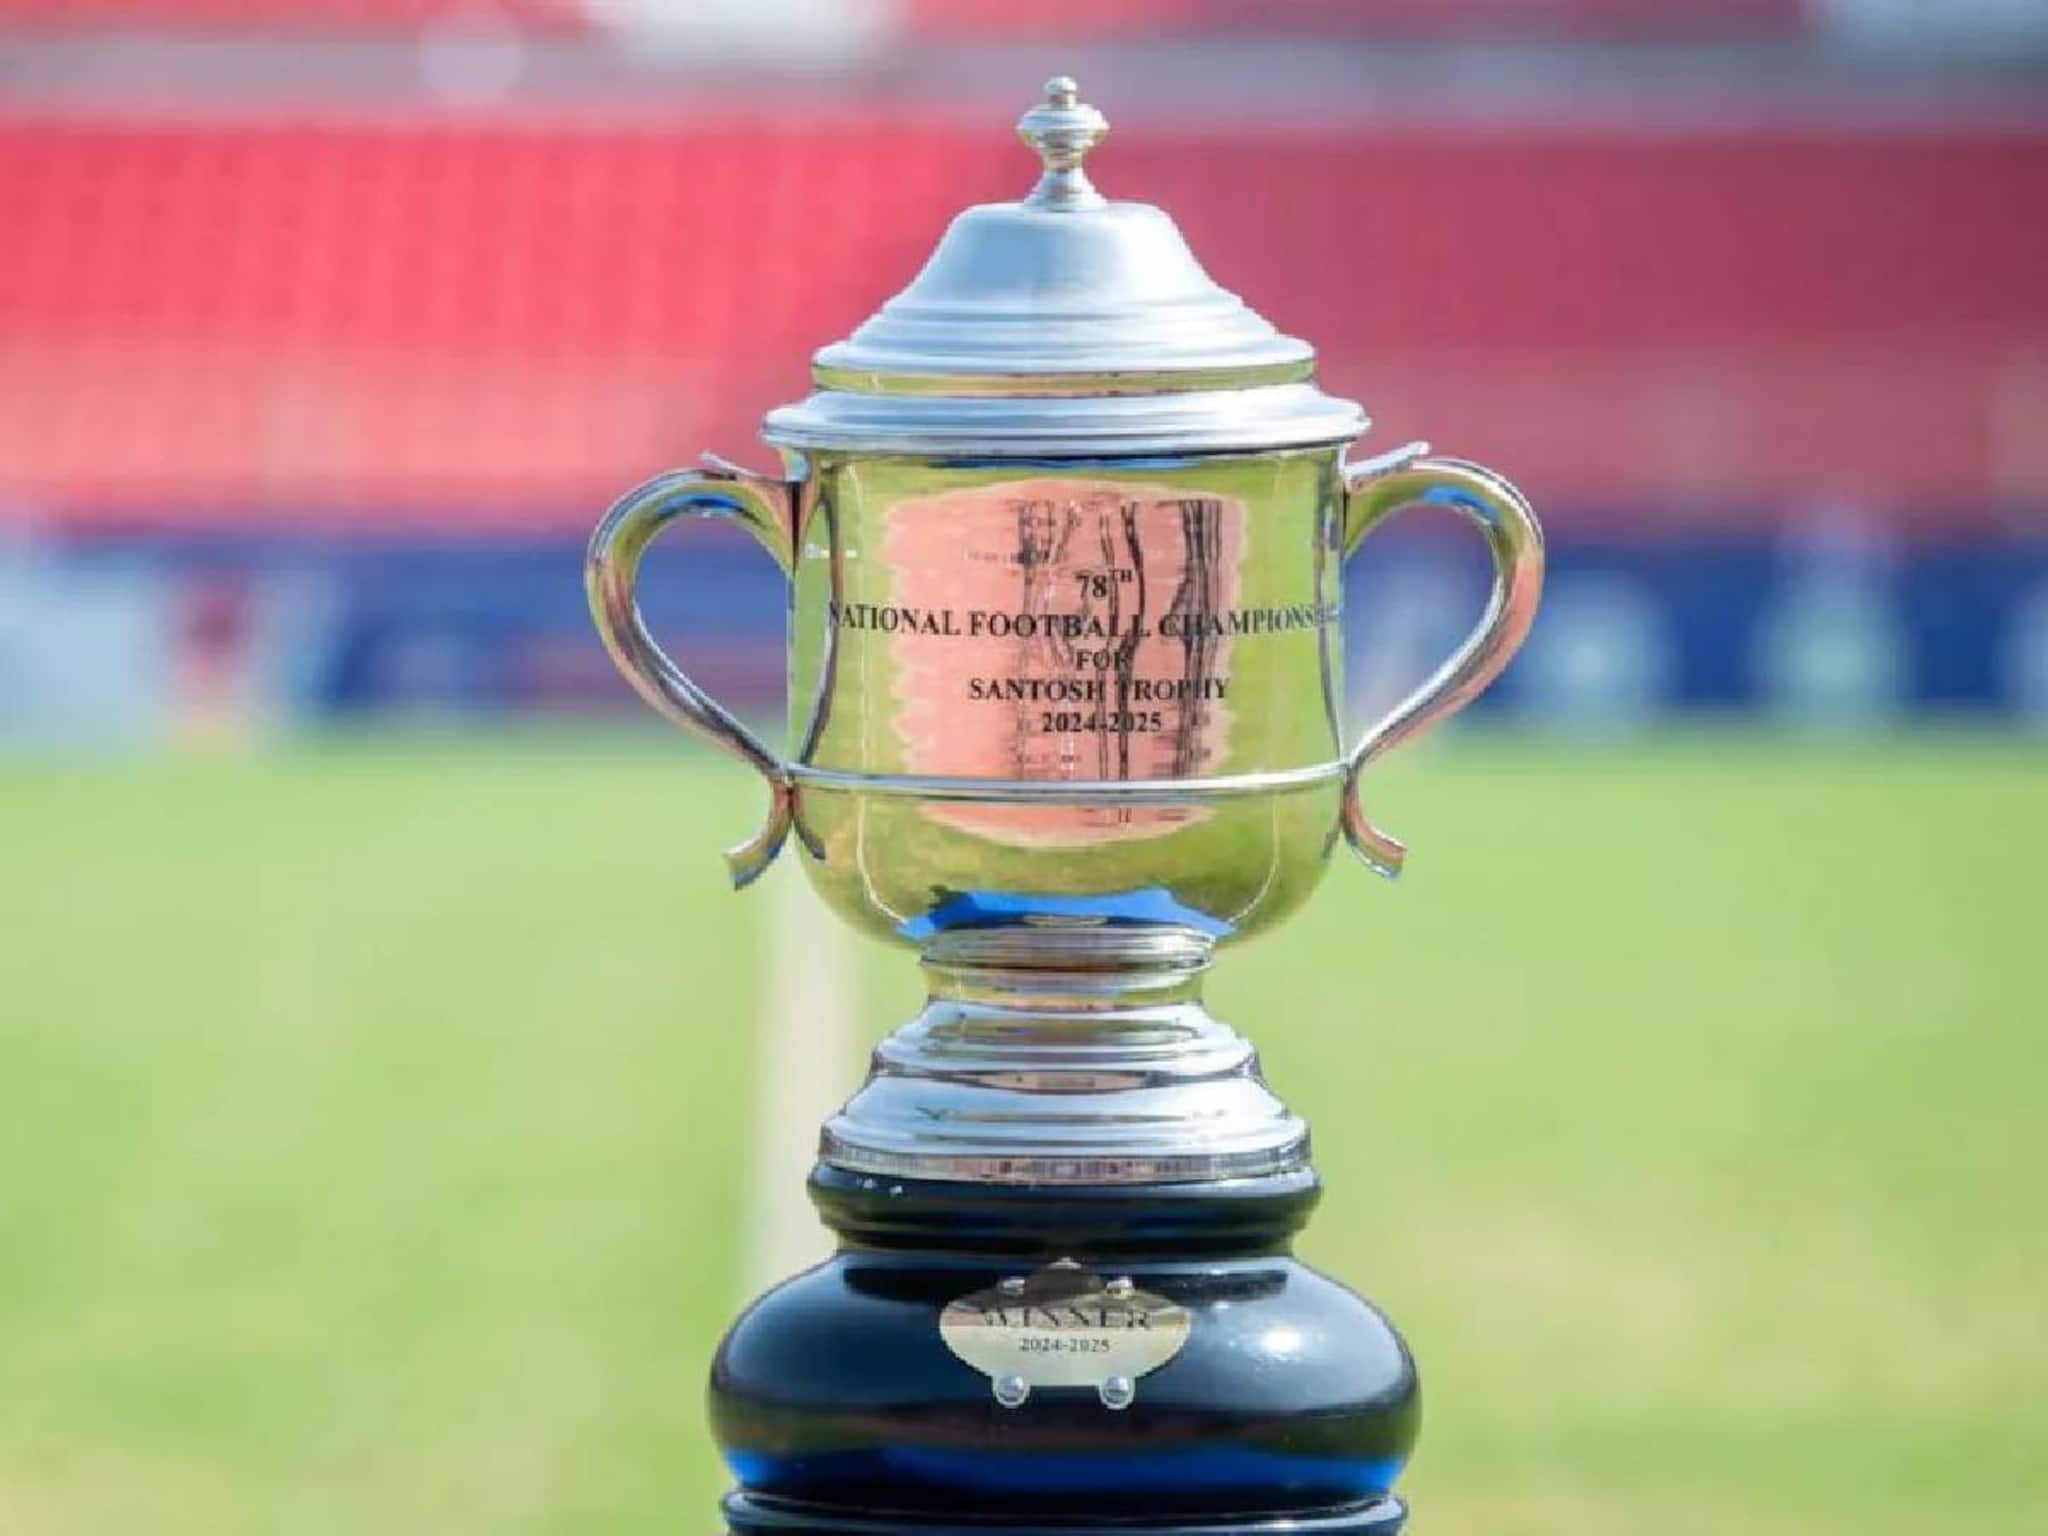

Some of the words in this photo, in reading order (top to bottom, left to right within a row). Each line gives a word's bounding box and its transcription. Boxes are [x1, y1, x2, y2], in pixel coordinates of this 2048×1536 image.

[1075, 569, 1133, 598] 78TH
[829, 602, 961, 636] NATIONAL
[970, 612, 1151, 637] FOOTBALL
[1076, 650, 1130, 671] FOR
[969, 679, 1105, 700] SANTOSH
[1114, 678, 1228, 700] TROPHY
[1042, 712, 1162, 733] 2024-2025
[978, 1306, 1151, 1328] WINNER
[1020, 1338, 1110, 1352] 2024-2025
